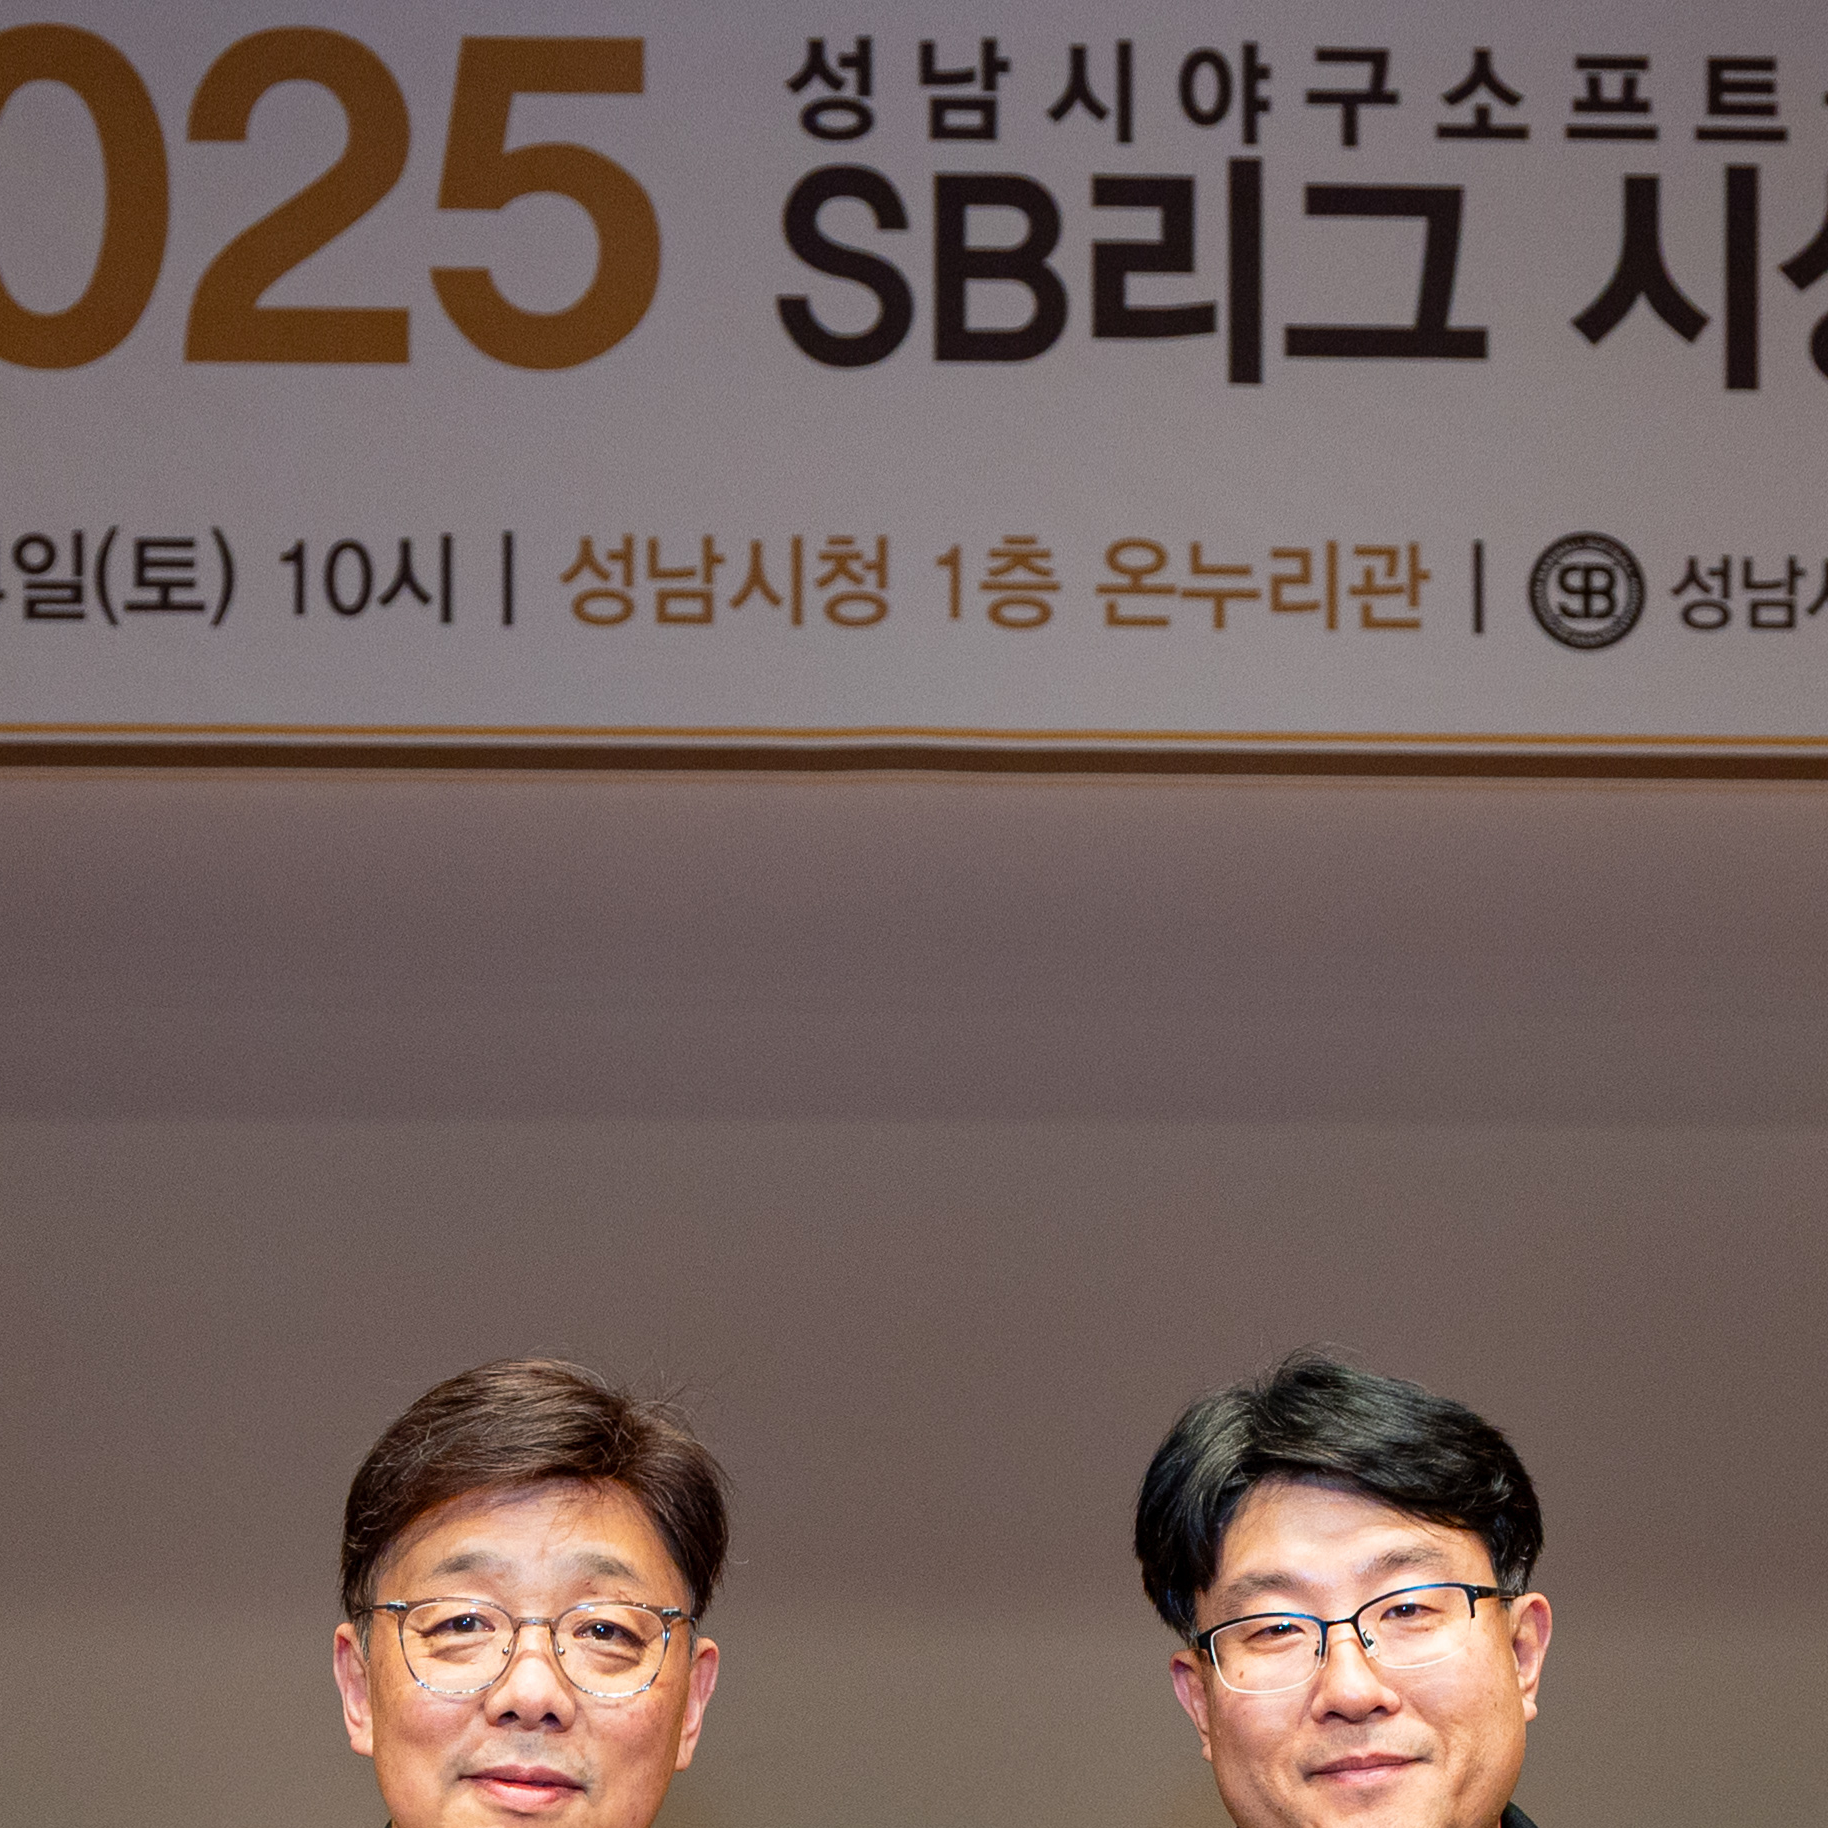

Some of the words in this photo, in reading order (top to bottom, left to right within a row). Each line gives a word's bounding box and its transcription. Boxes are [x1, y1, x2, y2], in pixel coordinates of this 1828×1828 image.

[775, 156, 1490, 387] SB리그
[279, 533, 454, 625] 10시
[559, 534, 889, 629] 성남시청
[936, 536, 1061, 630] 1층
[1095, 539, 1431, 631] 온누리관
